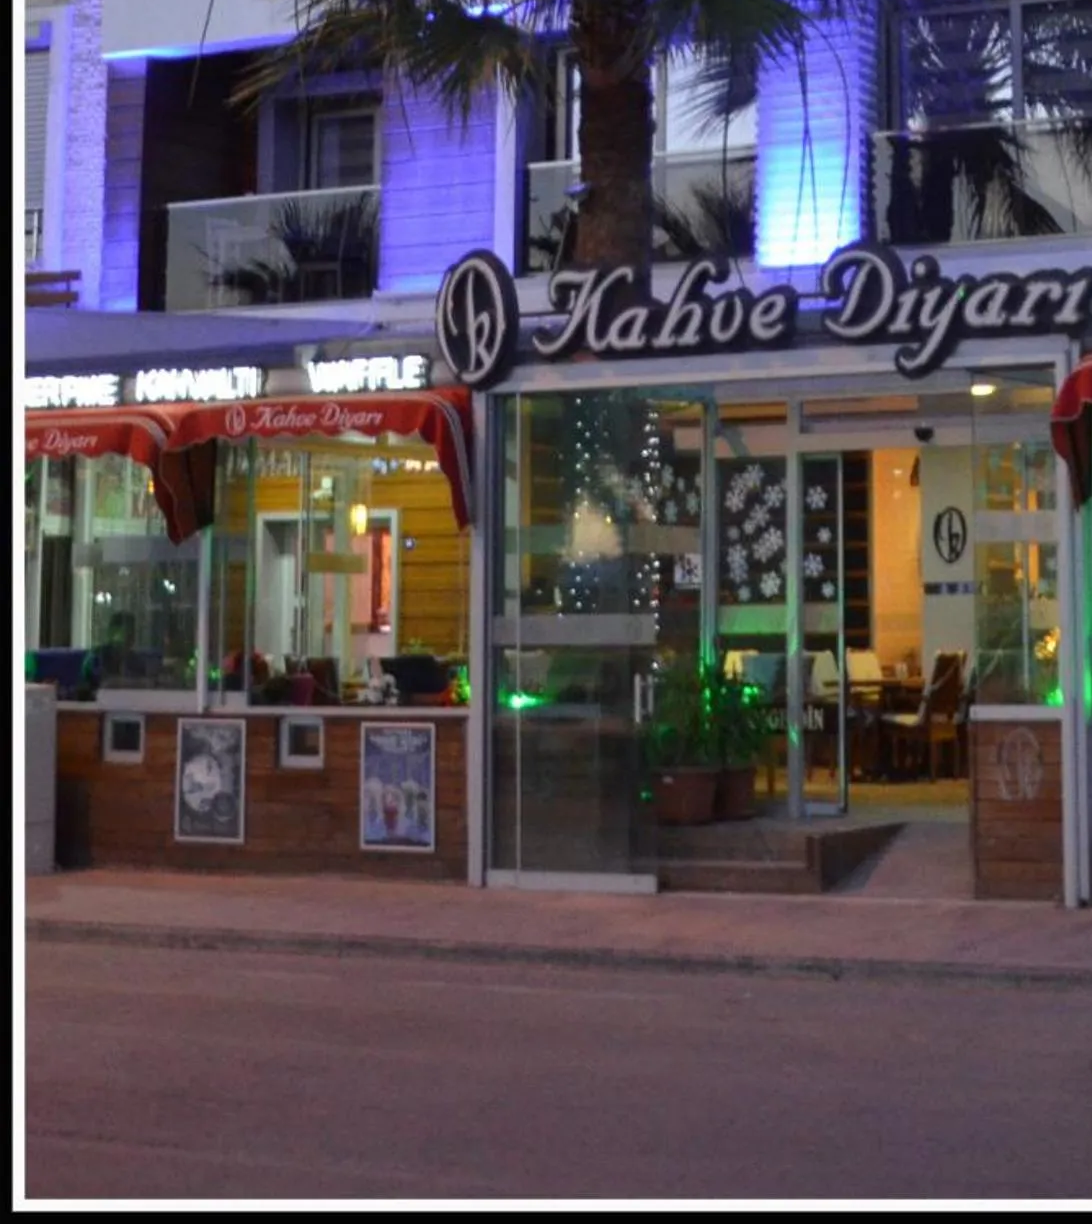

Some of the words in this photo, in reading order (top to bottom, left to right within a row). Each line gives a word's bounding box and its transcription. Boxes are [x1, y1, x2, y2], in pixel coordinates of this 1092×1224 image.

[532, 259, 788, 352] Kahve
[822, 248, 1092, 371] Diyarı
[307, 355, 427, 394] WAFFLE
[251, 403, 317, 429] Kahve
[320, 402, 383, 431] Diyarı
